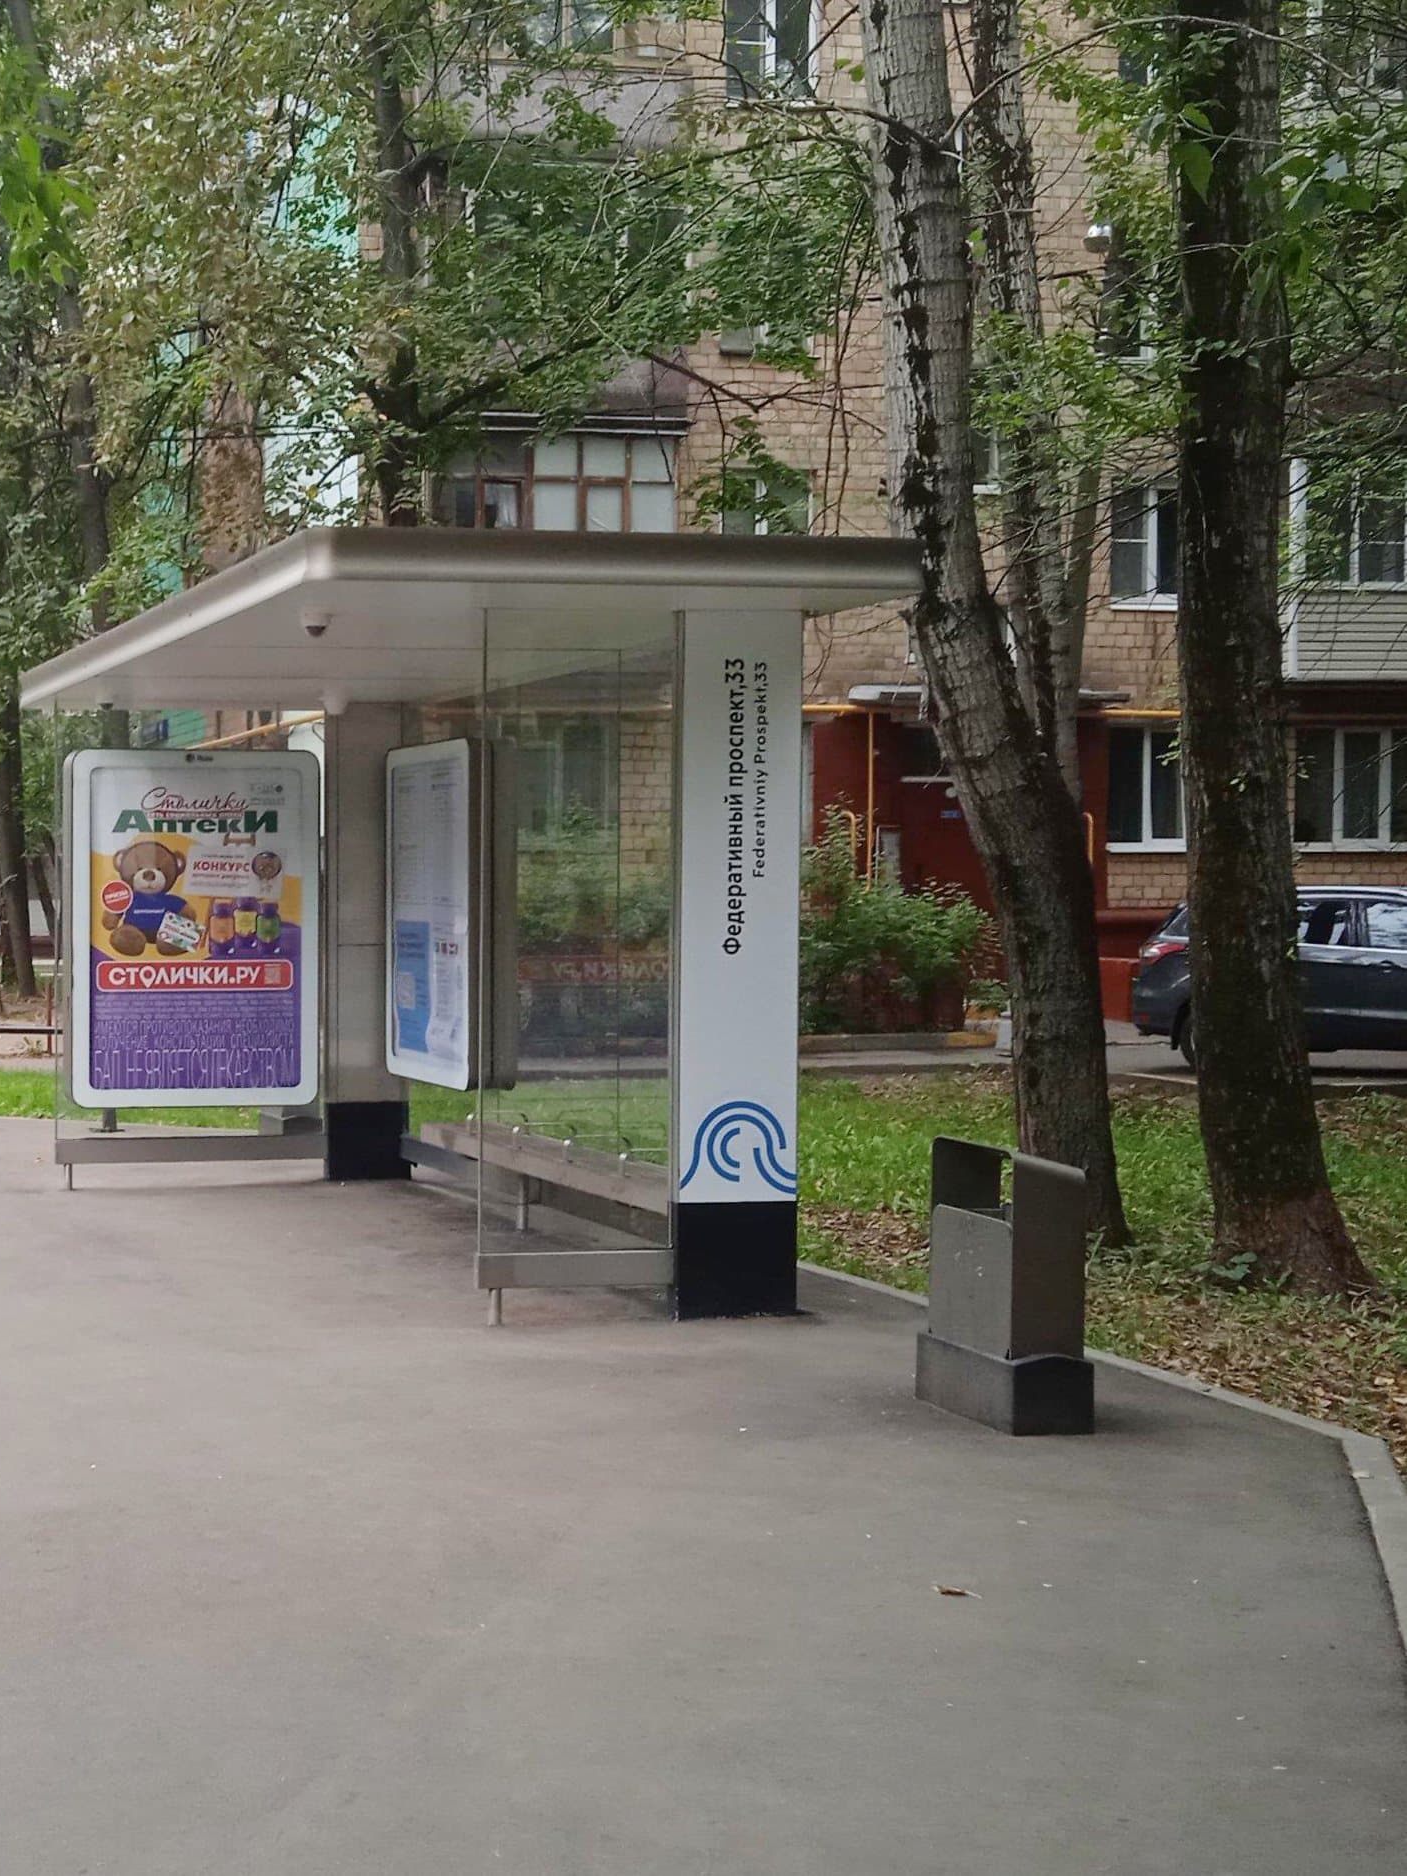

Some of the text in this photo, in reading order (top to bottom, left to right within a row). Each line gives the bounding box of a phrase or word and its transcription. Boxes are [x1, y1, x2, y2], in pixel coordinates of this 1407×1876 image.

[140, 786, 250, 811] Столички
[753, 769, 769, 878] Federativniy
[193, 861, 250, 873] КОНКУРС
[722, 794, 747, 955] Федеративный
[108, 965, 261, 989] СТОЛИЧКИ.РУ
